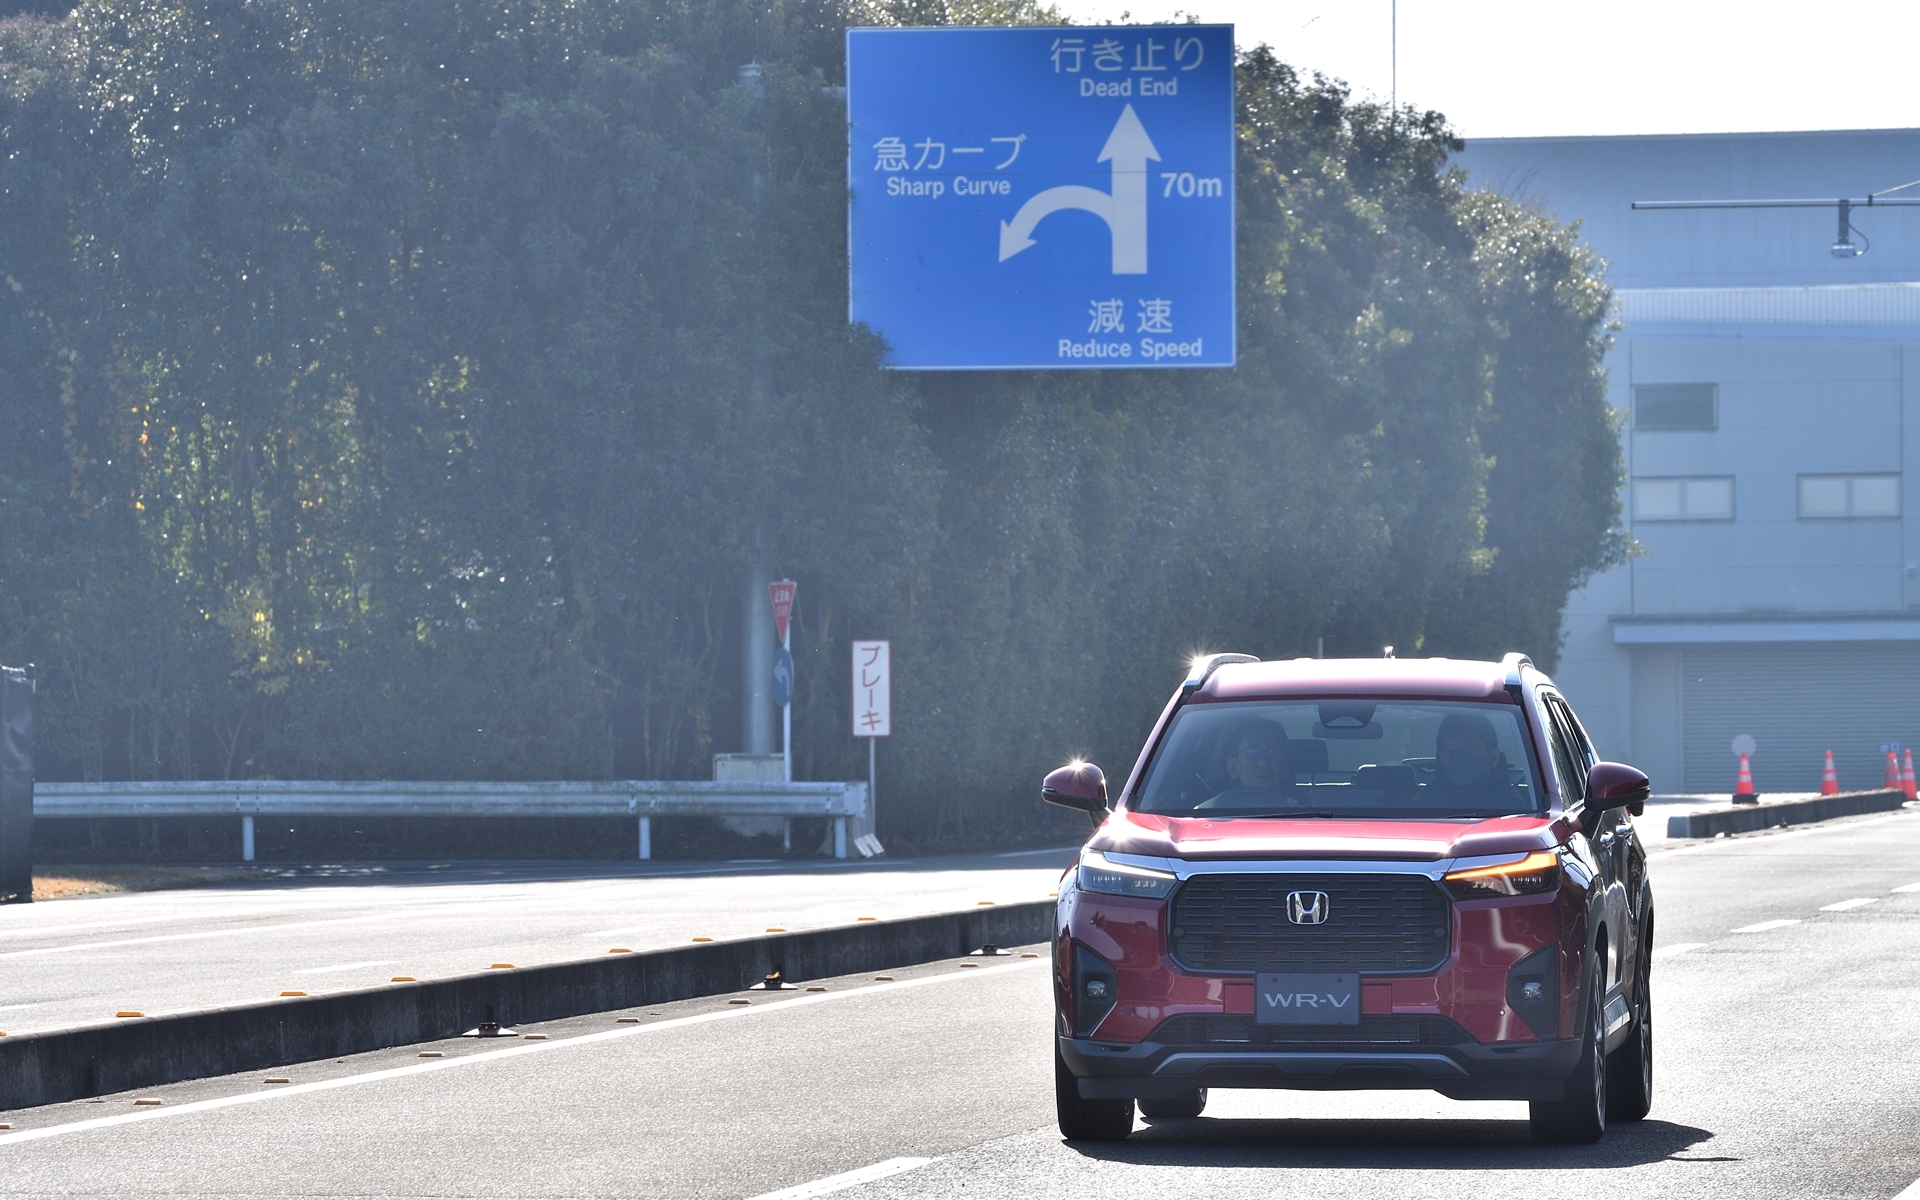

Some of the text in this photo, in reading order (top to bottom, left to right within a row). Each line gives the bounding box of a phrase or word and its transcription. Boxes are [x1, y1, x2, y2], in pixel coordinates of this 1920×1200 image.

[1050, 37, 1204, 73] 行き止り
[1080, 77, 1178, 97] Dead End
[873, 133, 1027, 171] 急カーブ
[887, 175, 1011, 199] Sharp Curve
[1161, 172, 1222, 197] 70m
[1058, 337, 1203, 361] Reduce Speed
[861, 645, 882, 731] ブレーキ
[1264, 993, 1351, 1008] WR-V
